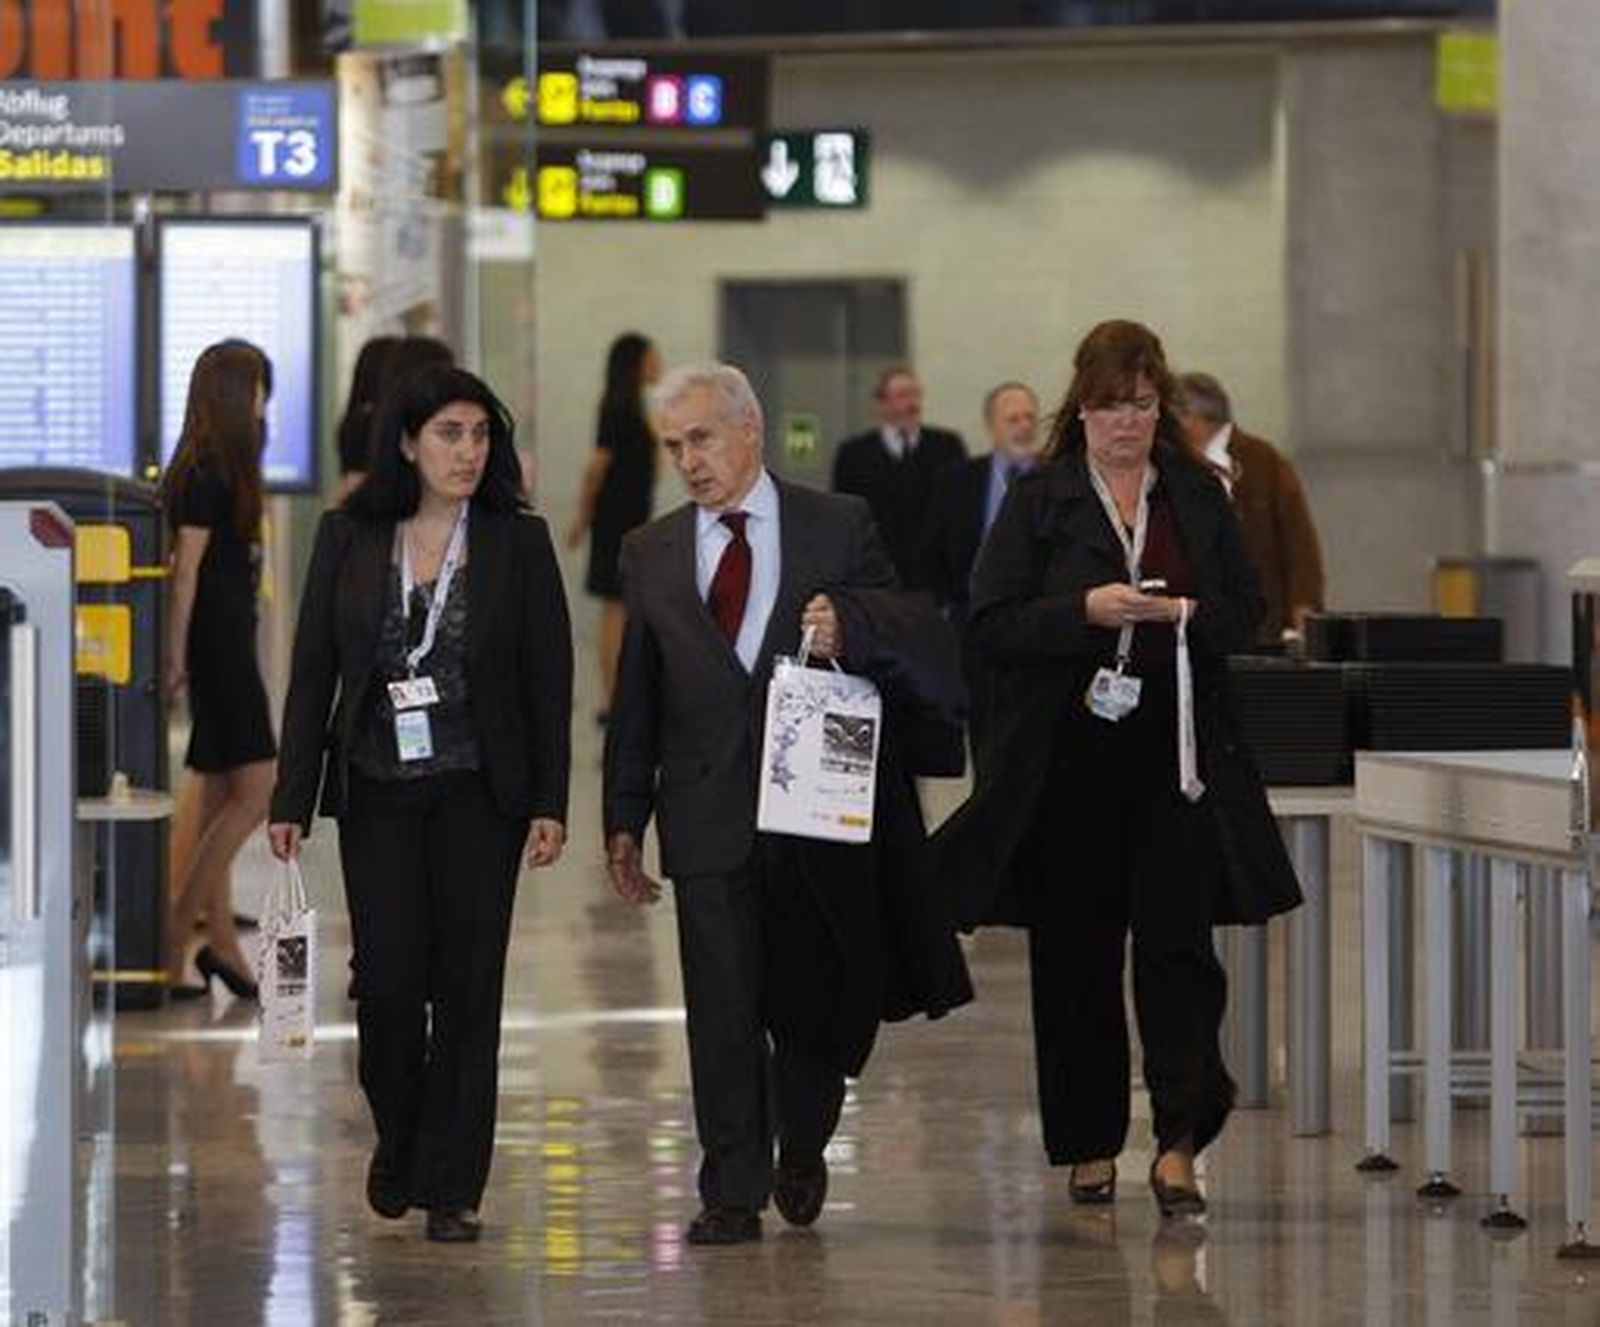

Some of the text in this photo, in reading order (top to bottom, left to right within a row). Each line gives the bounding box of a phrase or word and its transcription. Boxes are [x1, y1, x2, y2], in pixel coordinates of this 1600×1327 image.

[0, 121, 125, 149] Departures
[0, 149, 104, 179] Salidas
[250, 130, 317, 177] T3
